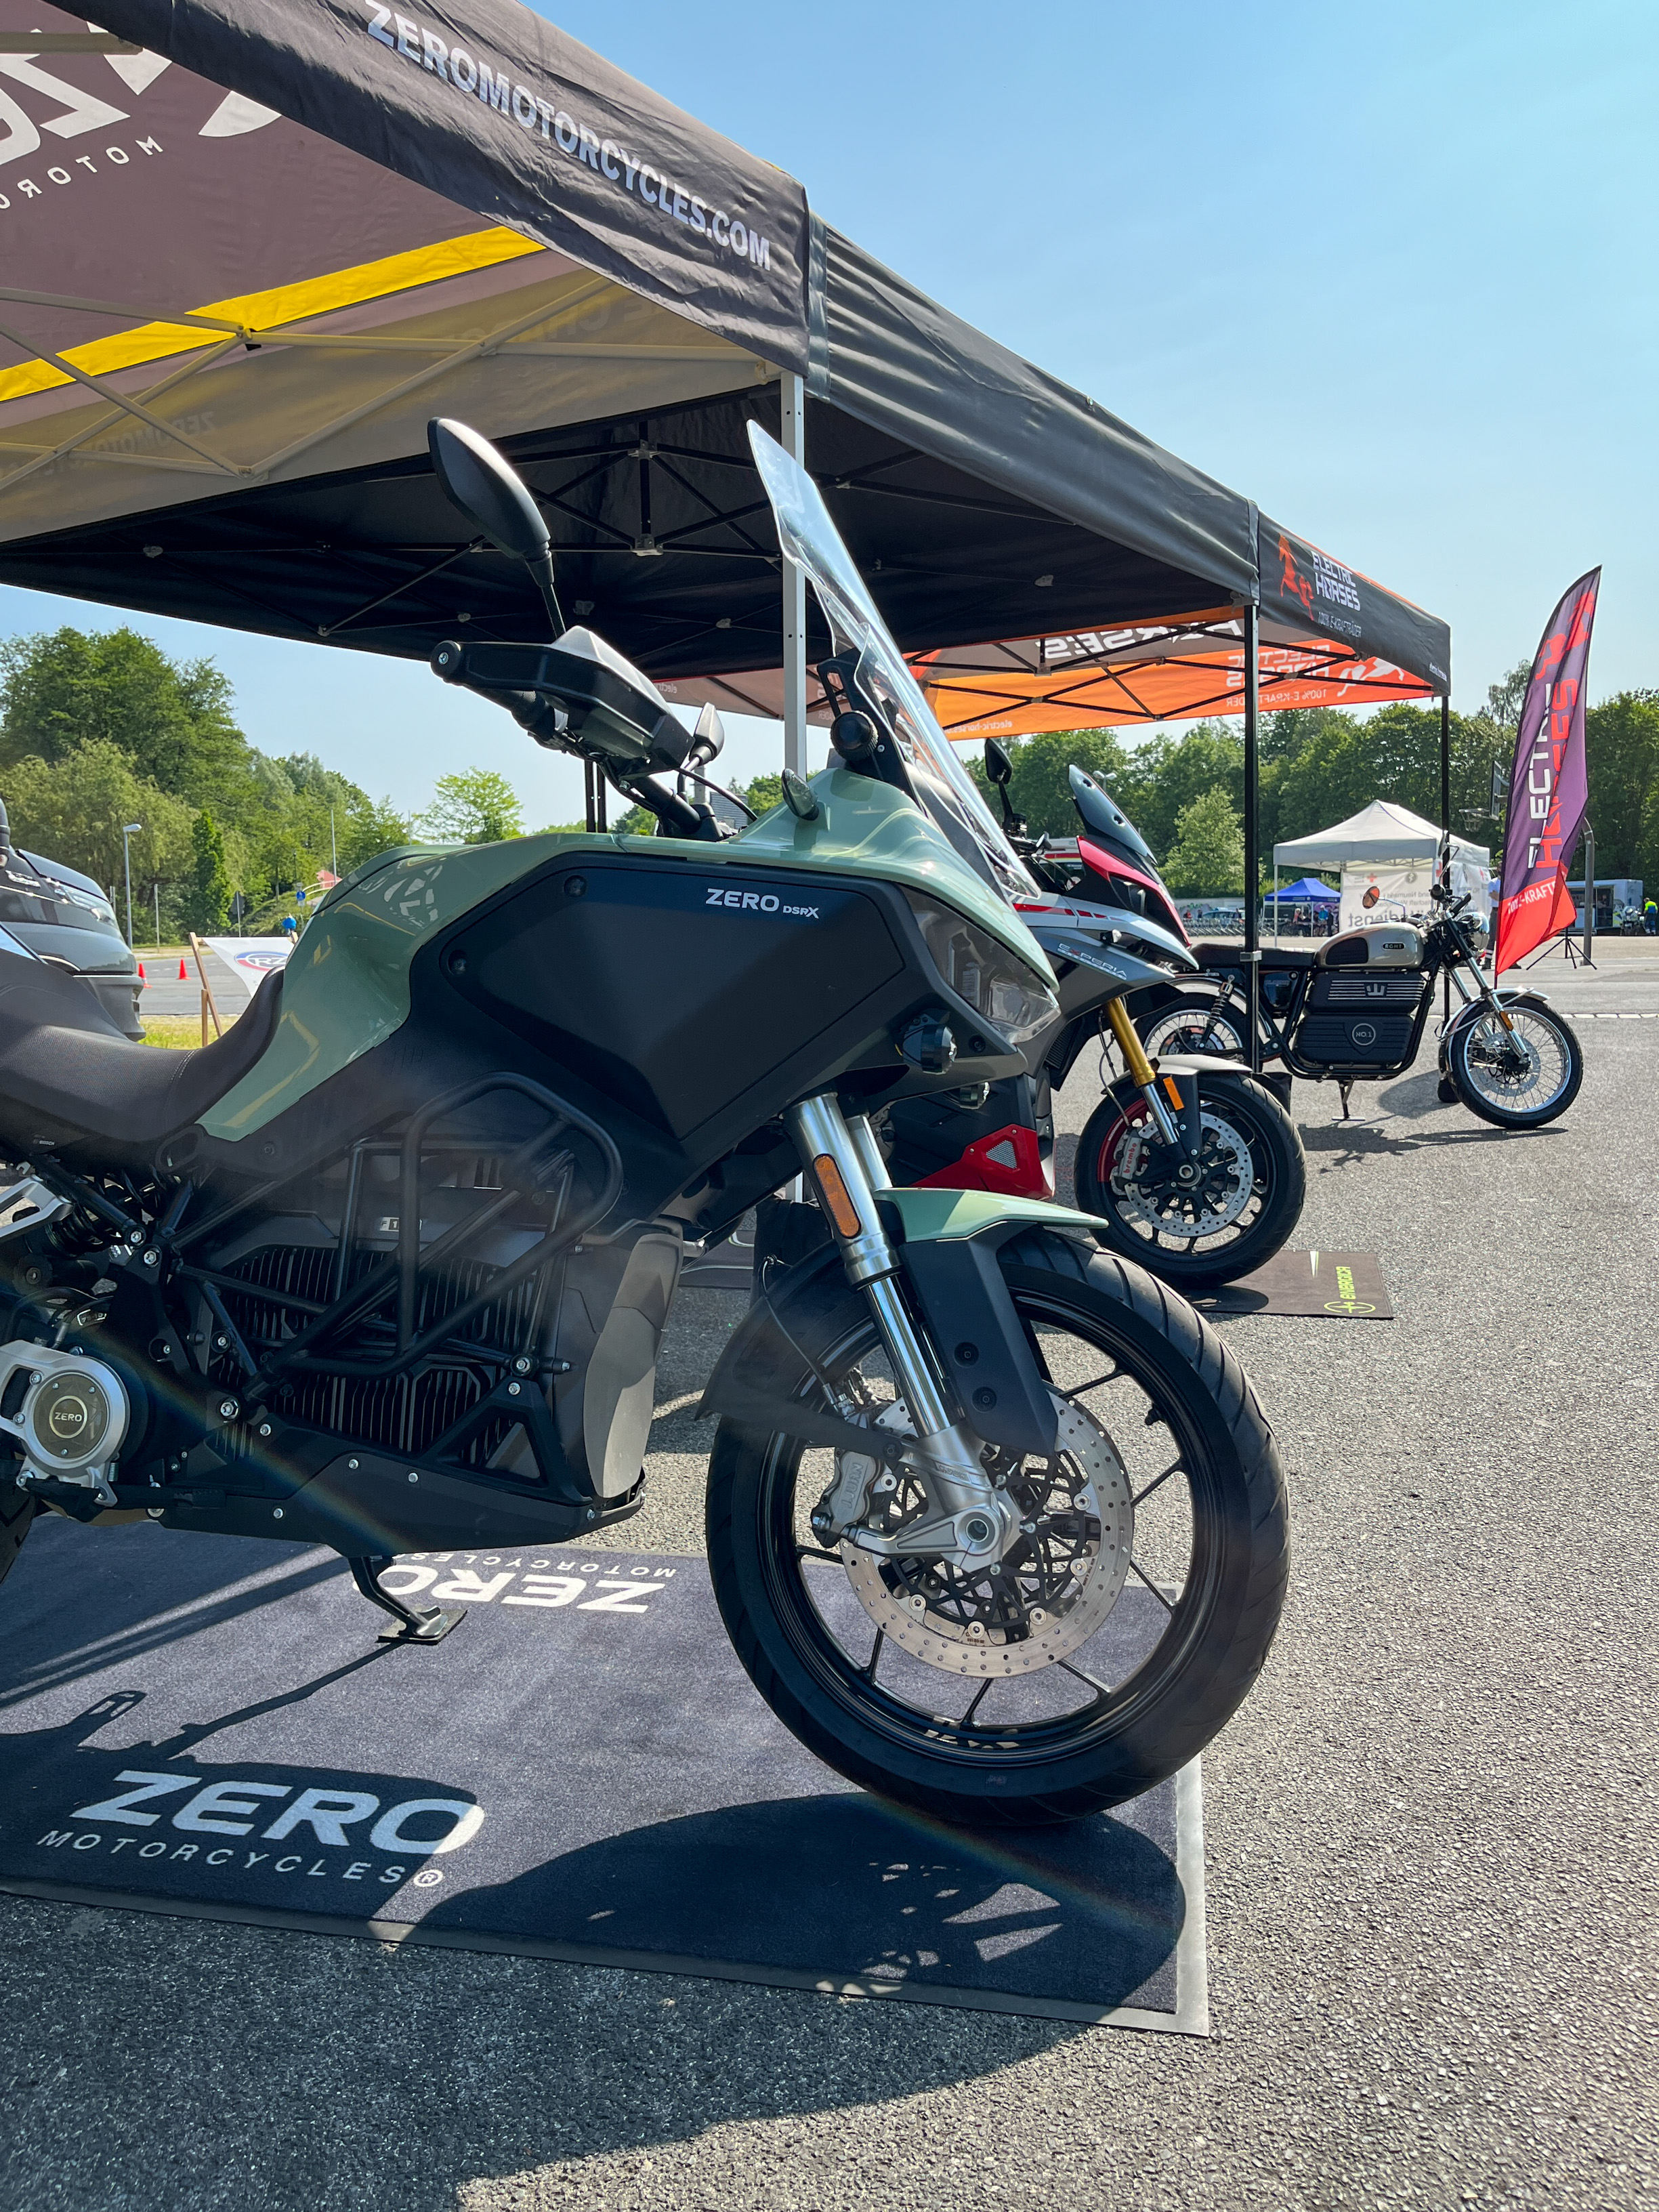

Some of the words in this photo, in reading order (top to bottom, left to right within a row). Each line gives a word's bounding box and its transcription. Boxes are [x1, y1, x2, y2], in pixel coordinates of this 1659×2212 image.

[366, 0, 771, 270] ZEROMOTORCYCLES.COM
[1311, 551, 1356, 587] ELECTRIC
[1315, 572, 1360, 611] HORSES
[705, 888, 780, 912] ZERO
[1059, 943, 1127, 978] EXPERIA
[1122, 1143, 1137, 1174] brembo
[1335, 1266, 1357, 1300] ENERGICA
[54, 1411, 83, 1423] ZERO
[352, 1564, 666, 1614] ZERO
[69, 1770, 486, 1855] ZERO
